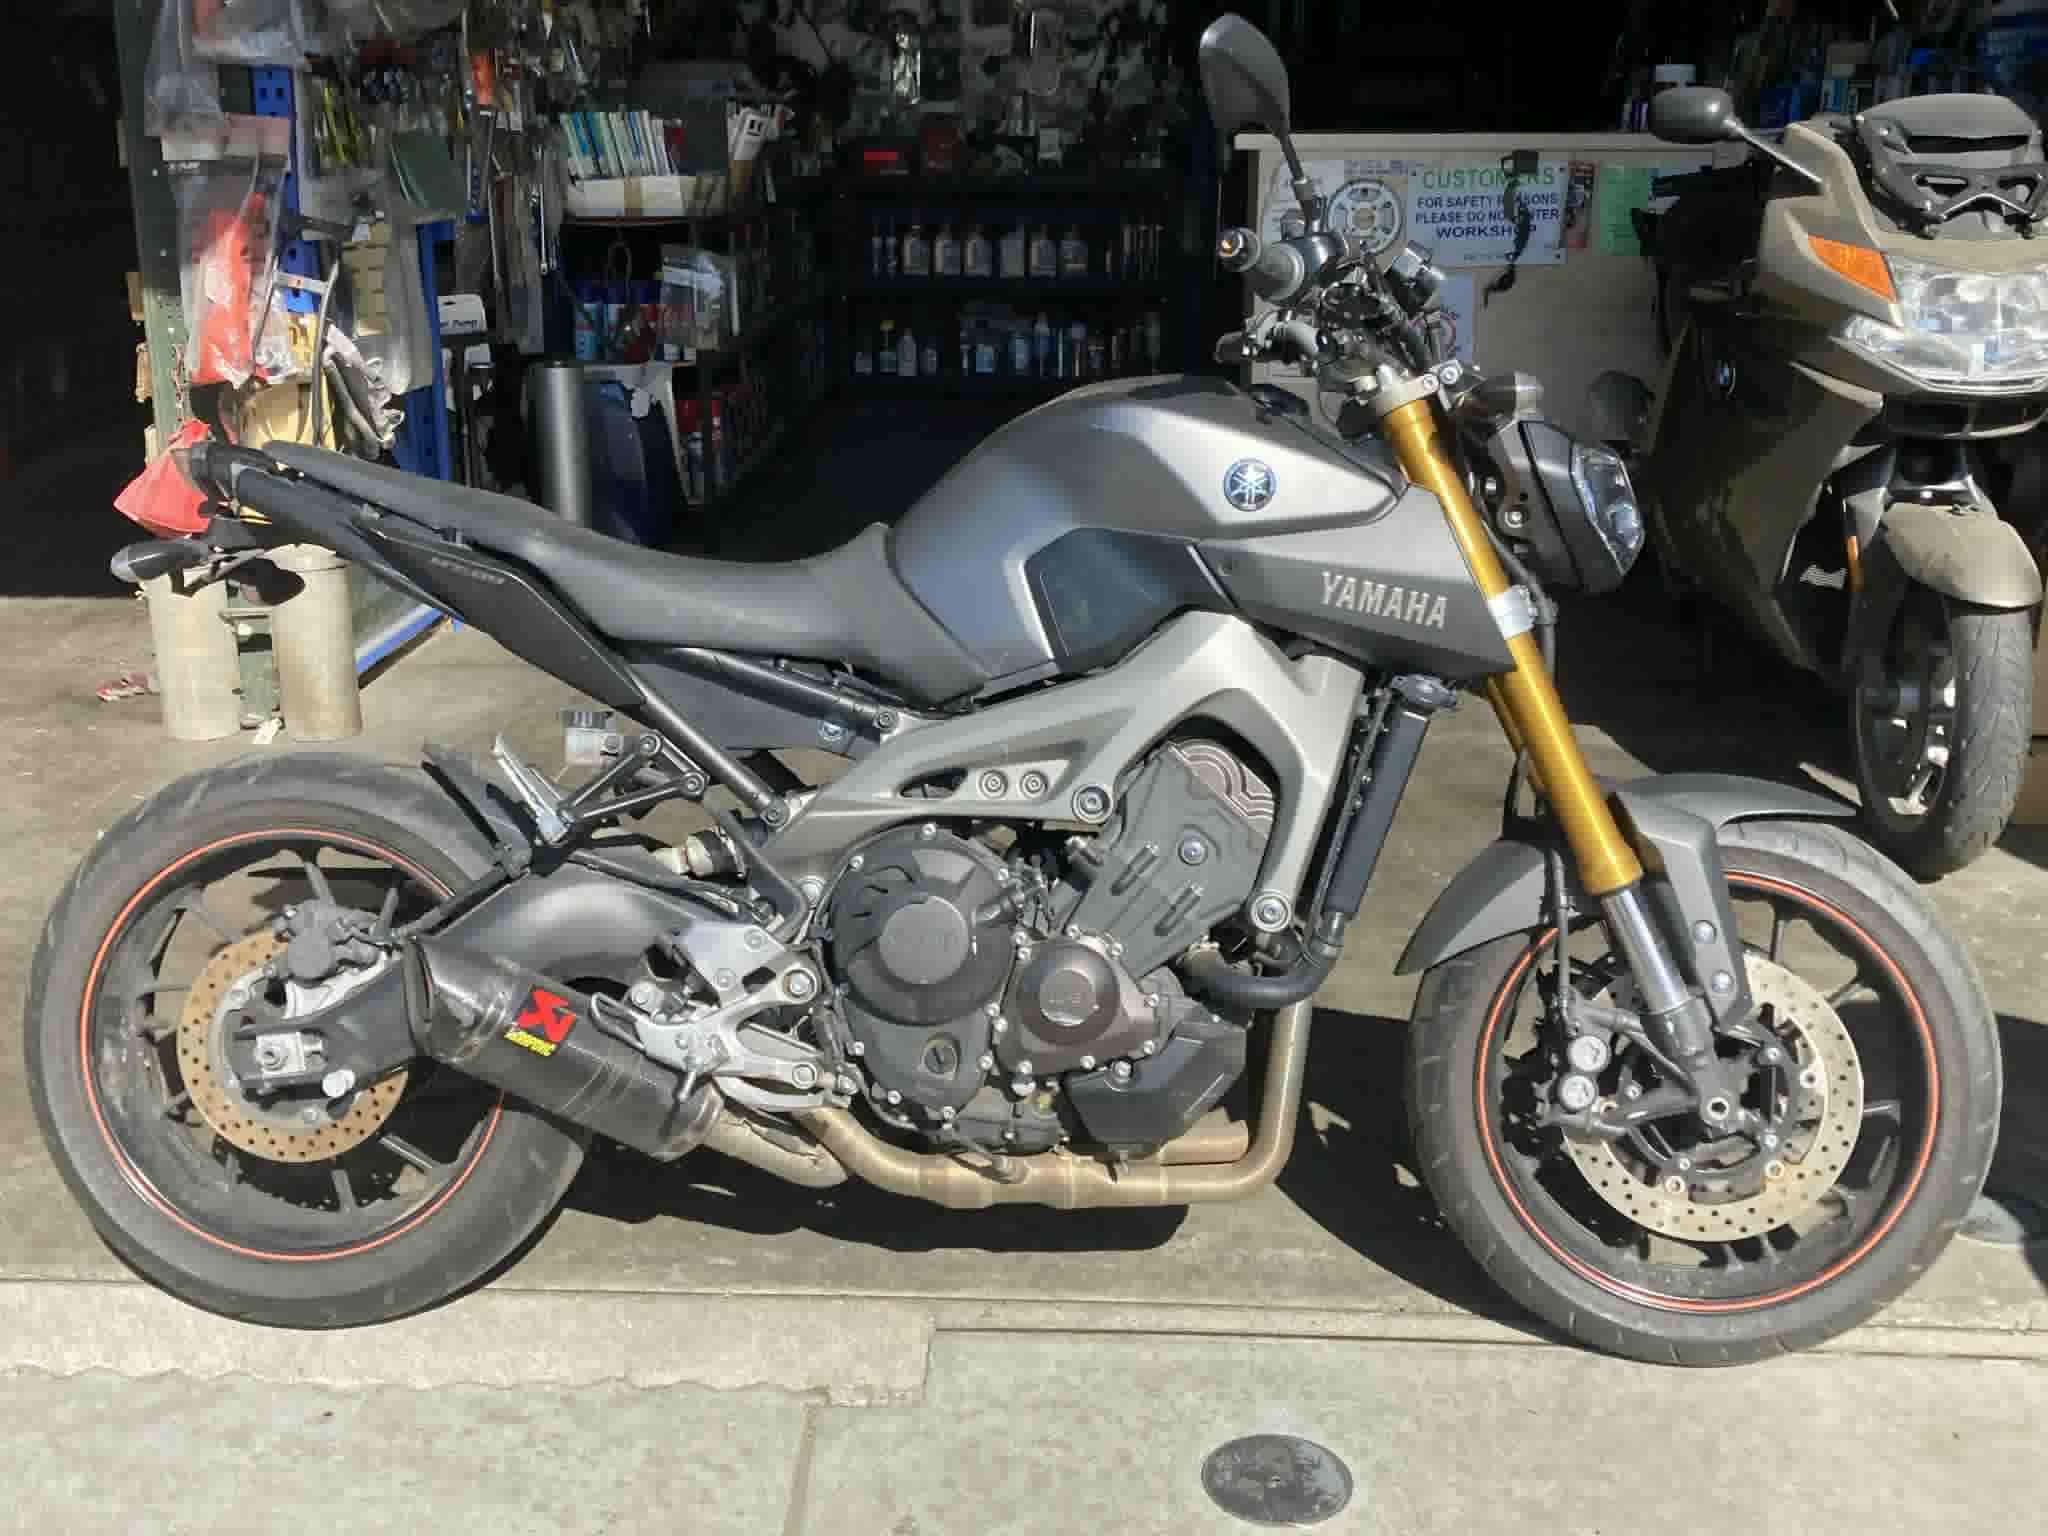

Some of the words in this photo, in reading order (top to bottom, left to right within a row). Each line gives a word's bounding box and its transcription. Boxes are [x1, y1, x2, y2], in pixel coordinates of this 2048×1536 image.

[1424, 168, 1554, 189] CUSTOMRS
[1417, 195, 1443, 209] FOR
[1447, 193, 1493, 208] SAFETY
[1497, 192, 1559, 207] RASONS
[1416, 210, 1464, 224] PLEASE
[1467, 210, 1486, 223] DO
[1488, 209, 1512, 223] NO
[1520, 208, 1560, 222] NTER
[1436, 224, 1537, 239] WORKSHP
[1321, 570, 1449, 630] YAMAHA
